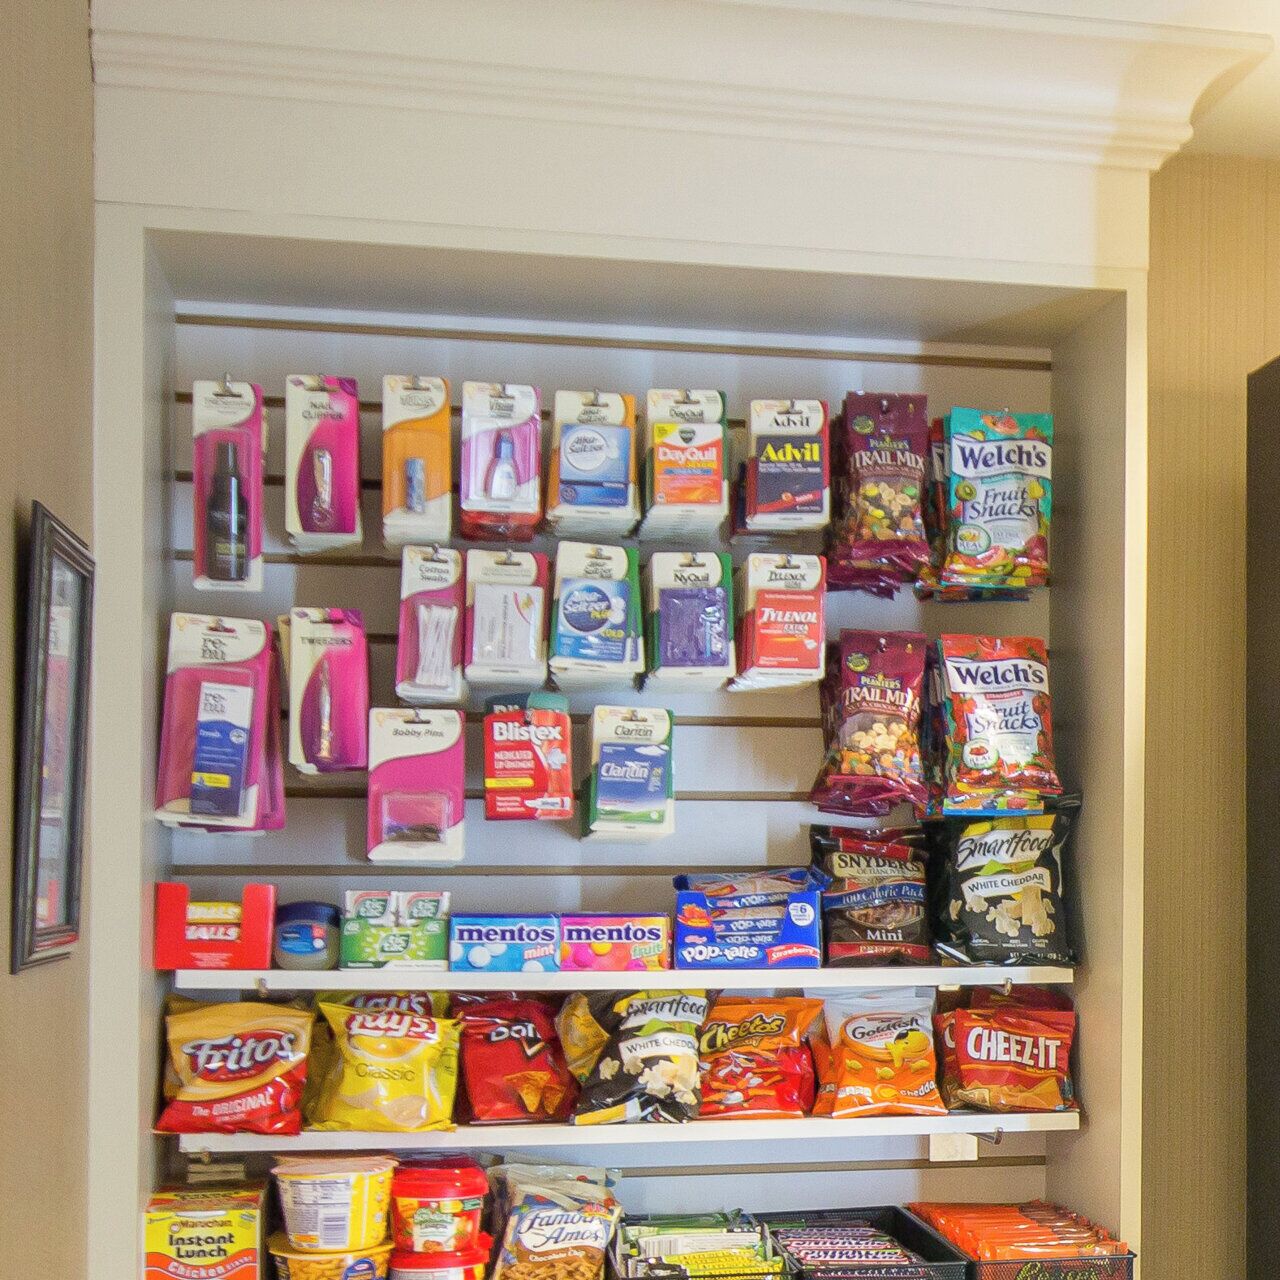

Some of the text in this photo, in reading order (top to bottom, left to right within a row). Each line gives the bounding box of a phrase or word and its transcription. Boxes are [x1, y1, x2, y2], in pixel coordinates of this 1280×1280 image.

[770, 414, 811, 428] Advil
[657, 446, 718, 465] DayQuil
[760, 442, 821, 463] Advil
[853, 451, 925, 470] TRAIL MIX
[956, 444, 1048, 469] Welch's
[984, 487, 1028, 503] Fruit
[969, 502, 1037, 520] Snacks
[419, 565, 449, 575] Cotton
[760, 607, 818, 624] TYLENOL
[955, 663, 1044, 686] Welch's
[843, 687, 888, 706] TRAIL
[392, 727, 445, 738] Bobby Pins
[492, 722, 562, 742] Blistex
[600, 762, 649, 779] Claritin
[956, 830, 1054, 869] Smartfood
[901, 885, 924, 898] Pack
[968, 874, 1044, 893] WHITE CHEDDAR
[456, 926, 556, 942] mentos
[564, 924, 662, 942] mentos
[867, 929, 904, 941] Mini
[523, 943, 556, 959] mint
[631, 942, 664, 959] fruit
[771, 947, 818, 961] Strawberry
[701, 1014, 786, 1055] Cheetos
[851, 1016, 920, 1041] Goldfish
[180, 1031, 298, 1078] Fritos
[626, 1039, 661, 1054] WHITE
[966, 1026, 1063, 1068] CHEEZ-IT
[354, 1062, 416, 1081] Classic
[191, 1092, 273, 1117] The ORIGINAL
[168, 1233, 234, 1246] Instant
[533, 1226, 603, 1249] Amos
[176, 1245, 228, 1259] Lunch
[167, 1261, 226, 1279] Chicken
